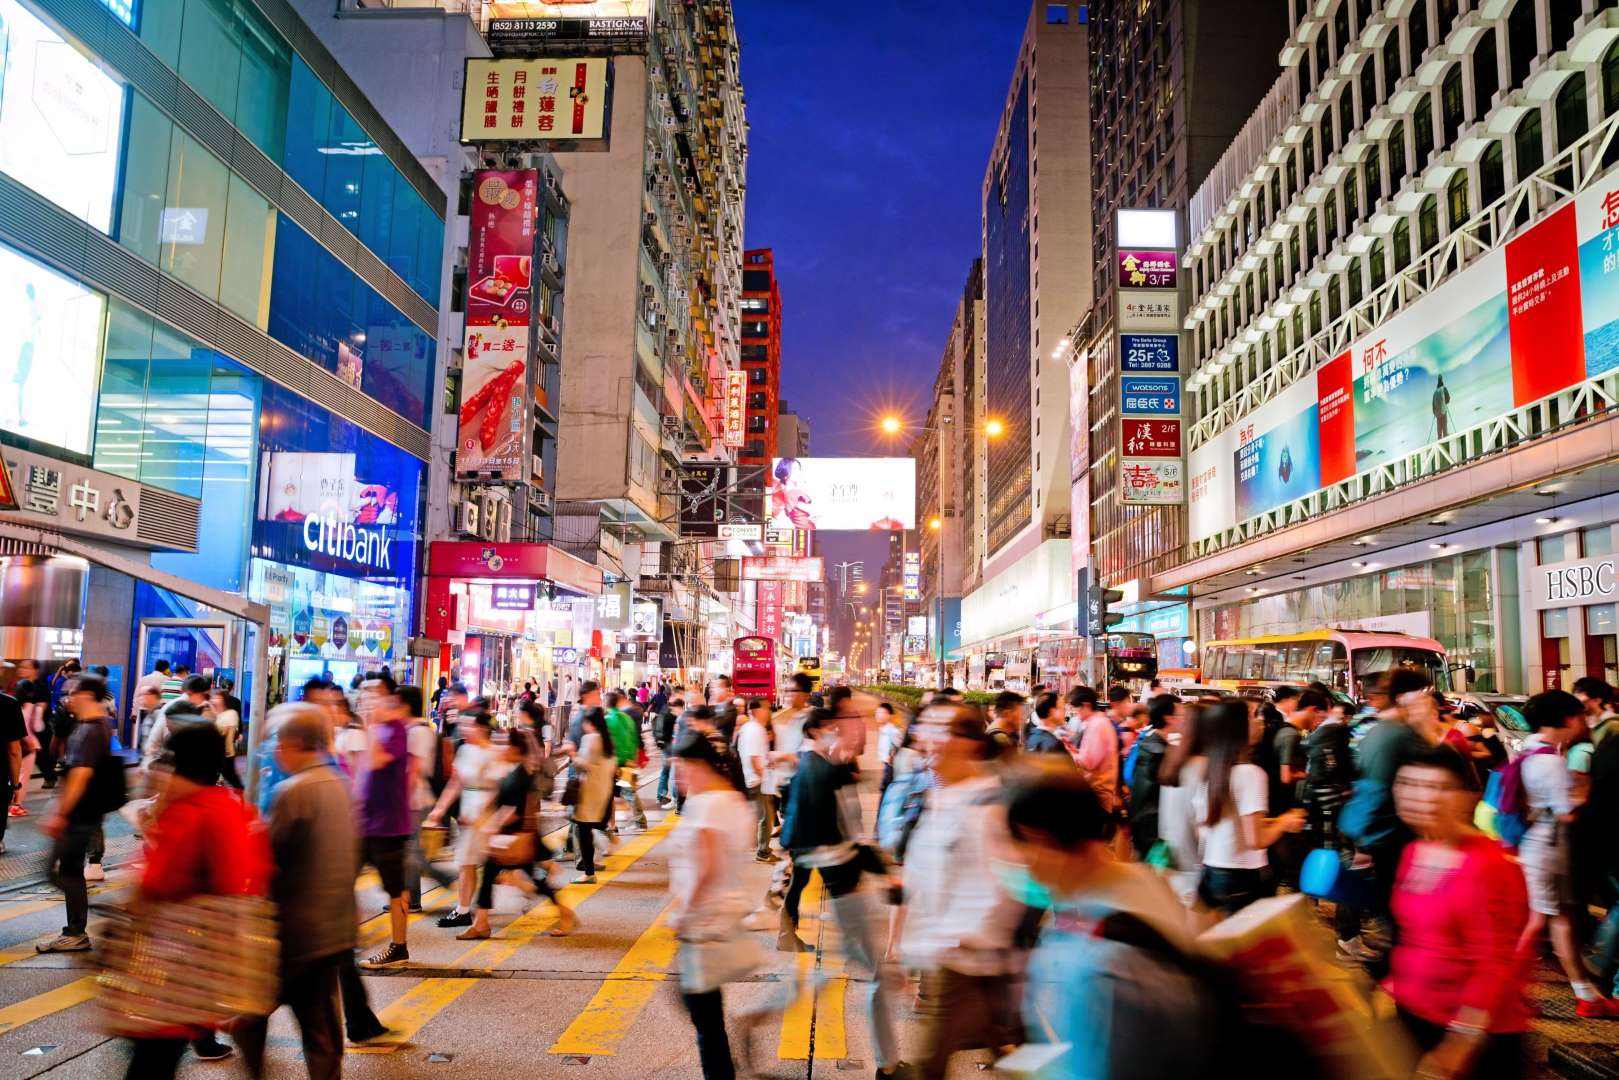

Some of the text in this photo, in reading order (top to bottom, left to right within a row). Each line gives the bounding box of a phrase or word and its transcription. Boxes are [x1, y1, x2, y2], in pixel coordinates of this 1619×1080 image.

[492, 22, 512, 30] (852)
[589, 20, 644, 28] RASTIGNAC
[1149, 274, 1170, 285] 3/F
[1363, 339, 1386, 374] 何不
[1126, 398, 1160, 409] 屈臣氏
[1161, 424, 1176, 433] 2/F
[303, 511, 391, 570] citibank
[1546, 562, 1616, 601] HSBC
